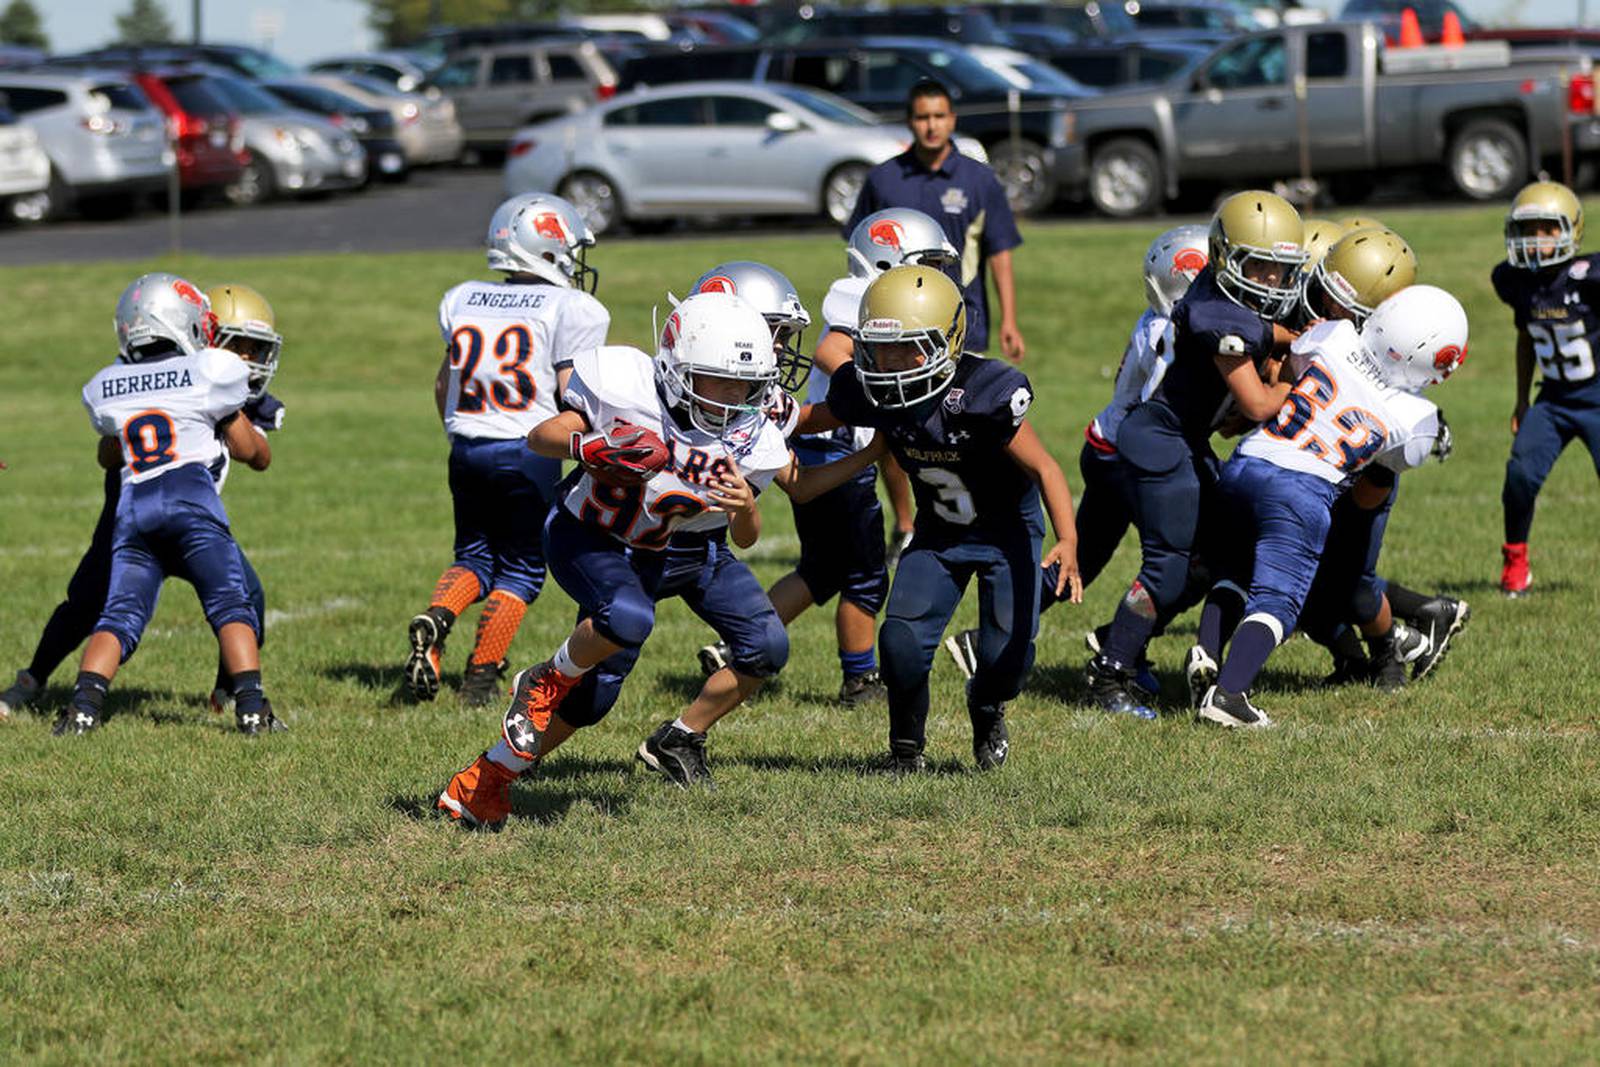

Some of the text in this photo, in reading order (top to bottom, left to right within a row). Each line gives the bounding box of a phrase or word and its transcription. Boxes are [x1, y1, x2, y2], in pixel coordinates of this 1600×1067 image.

[467, 291, 546, 308] ENGELKE
[450, 324, 537, 414] 23
[1527, 319, 1595, 381] 25
[102, 370, 193, 399] HERRERA
[1264, 361, 1389, 471] 62
[123, 407, 179, 474] 8
[579, 476, 713, 550] 92
[917, 467, 977, 525] 3
